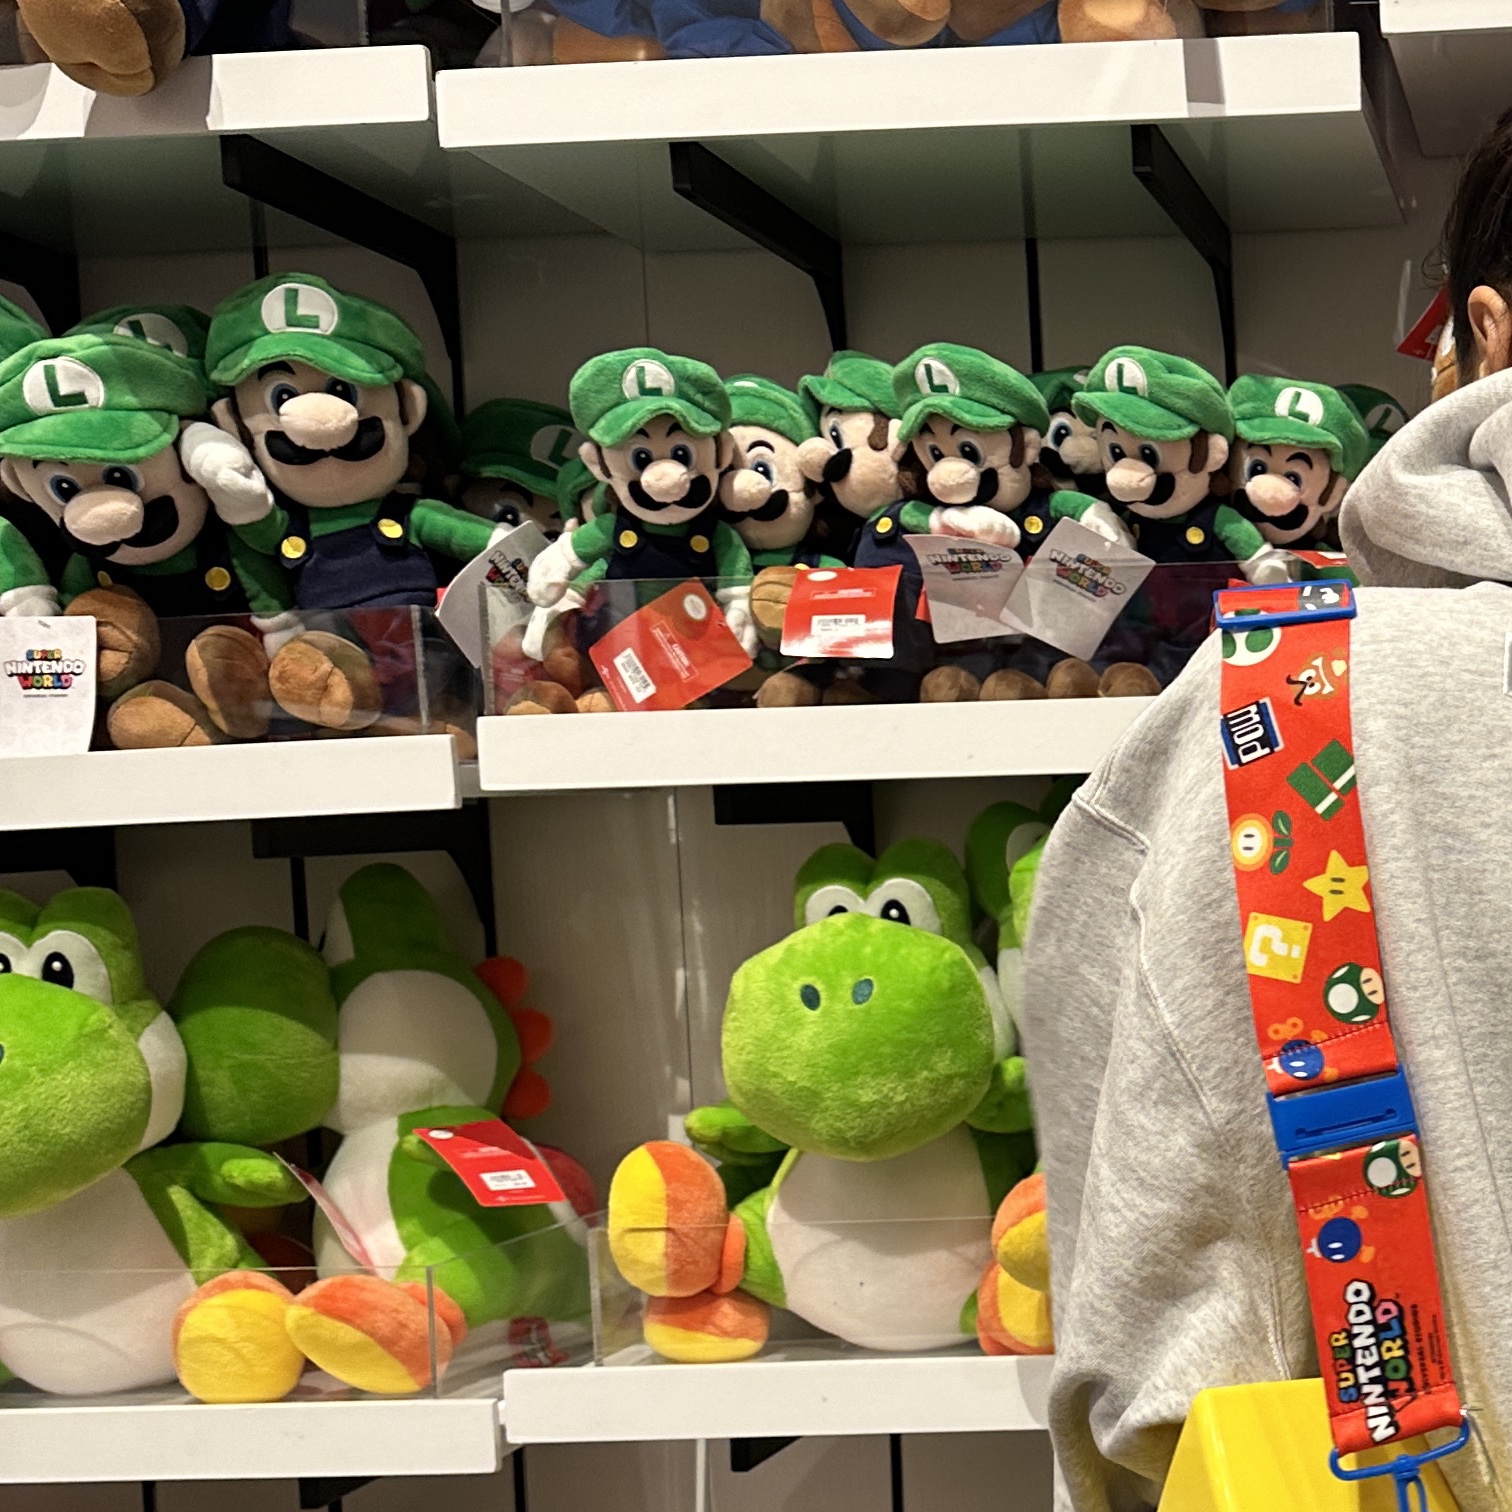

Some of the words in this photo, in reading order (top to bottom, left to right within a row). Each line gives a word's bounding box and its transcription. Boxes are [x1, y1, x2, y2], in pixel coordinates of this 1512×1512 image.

[284, 287, 320, 329] L
[43, 364, 89, 408] L
[635, 365, 663, 397] L
[924, 363, 949, 393] L
[1116, 362, 1139, 396] L
[1288, 390, 1310, 423] L
[1050, 550, 1126, 595] NINTENDO
[1056, 563, 1109, 598] WORLD
[4, 659, 86, 677] NINTENDO
[17, 674, 72, 690] WORLD
[1226, 703, 1271, 764] POW
[1328, 1328, 1359, 1403] SUPER
[1343, 1278, 1399, 1443] NINTENDO
